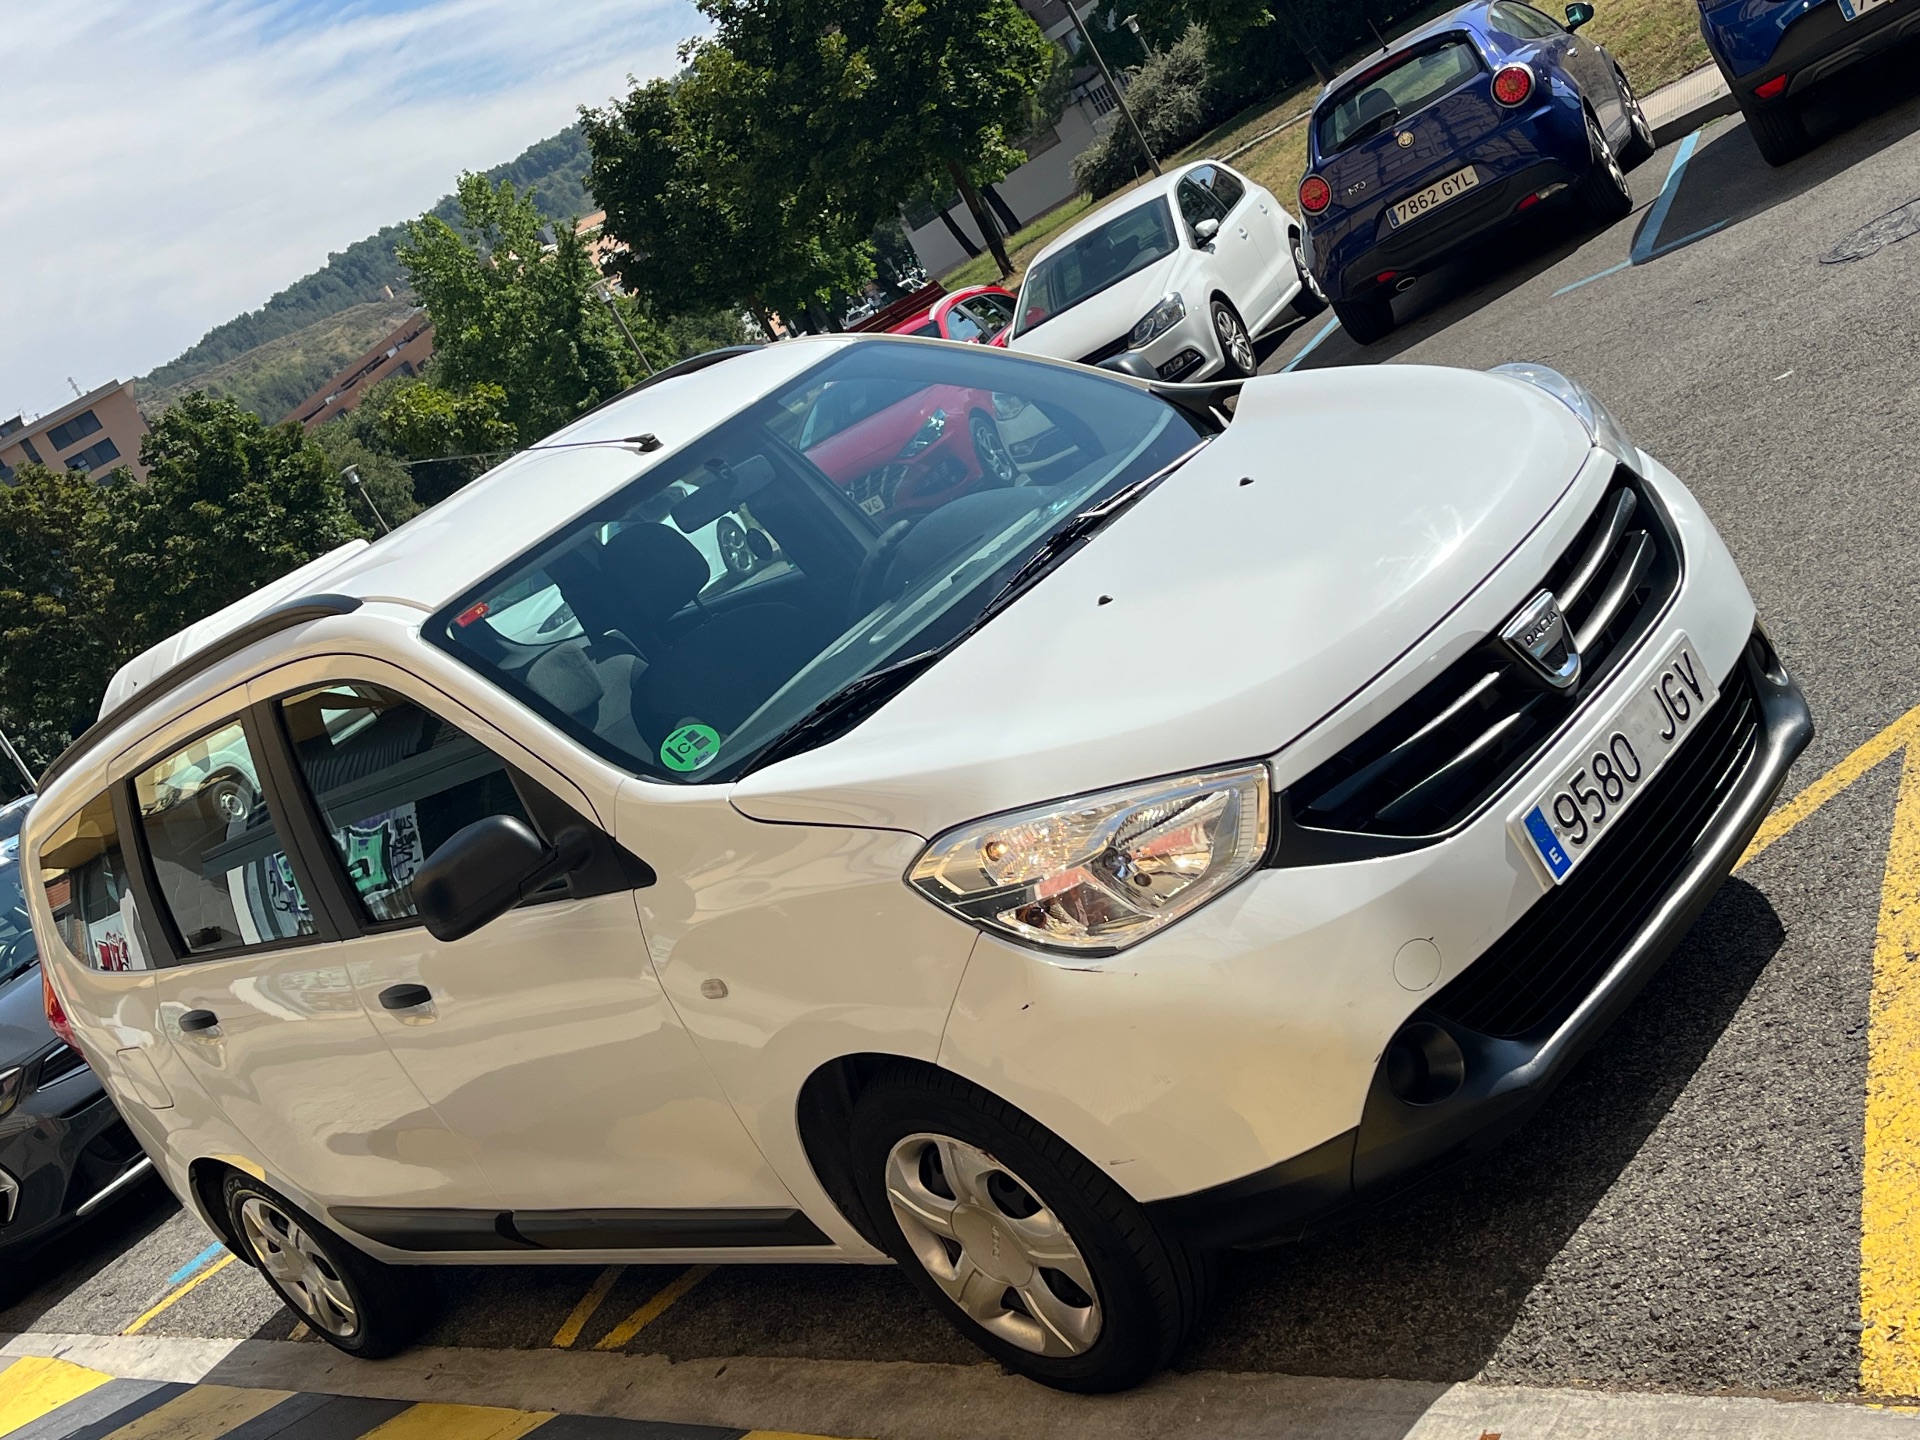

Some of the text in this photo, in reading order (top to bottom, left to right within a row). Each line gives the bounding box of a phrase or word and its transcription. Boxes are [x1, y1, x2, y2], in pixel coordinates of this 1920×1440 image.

[1397, 172, 1474, 220] 7862 GYL
[1524, 611, 1558, 646] DACIA
[677, 742, 692, 754] C
[1548, 649, 1704, 864] E 9580 JGV
